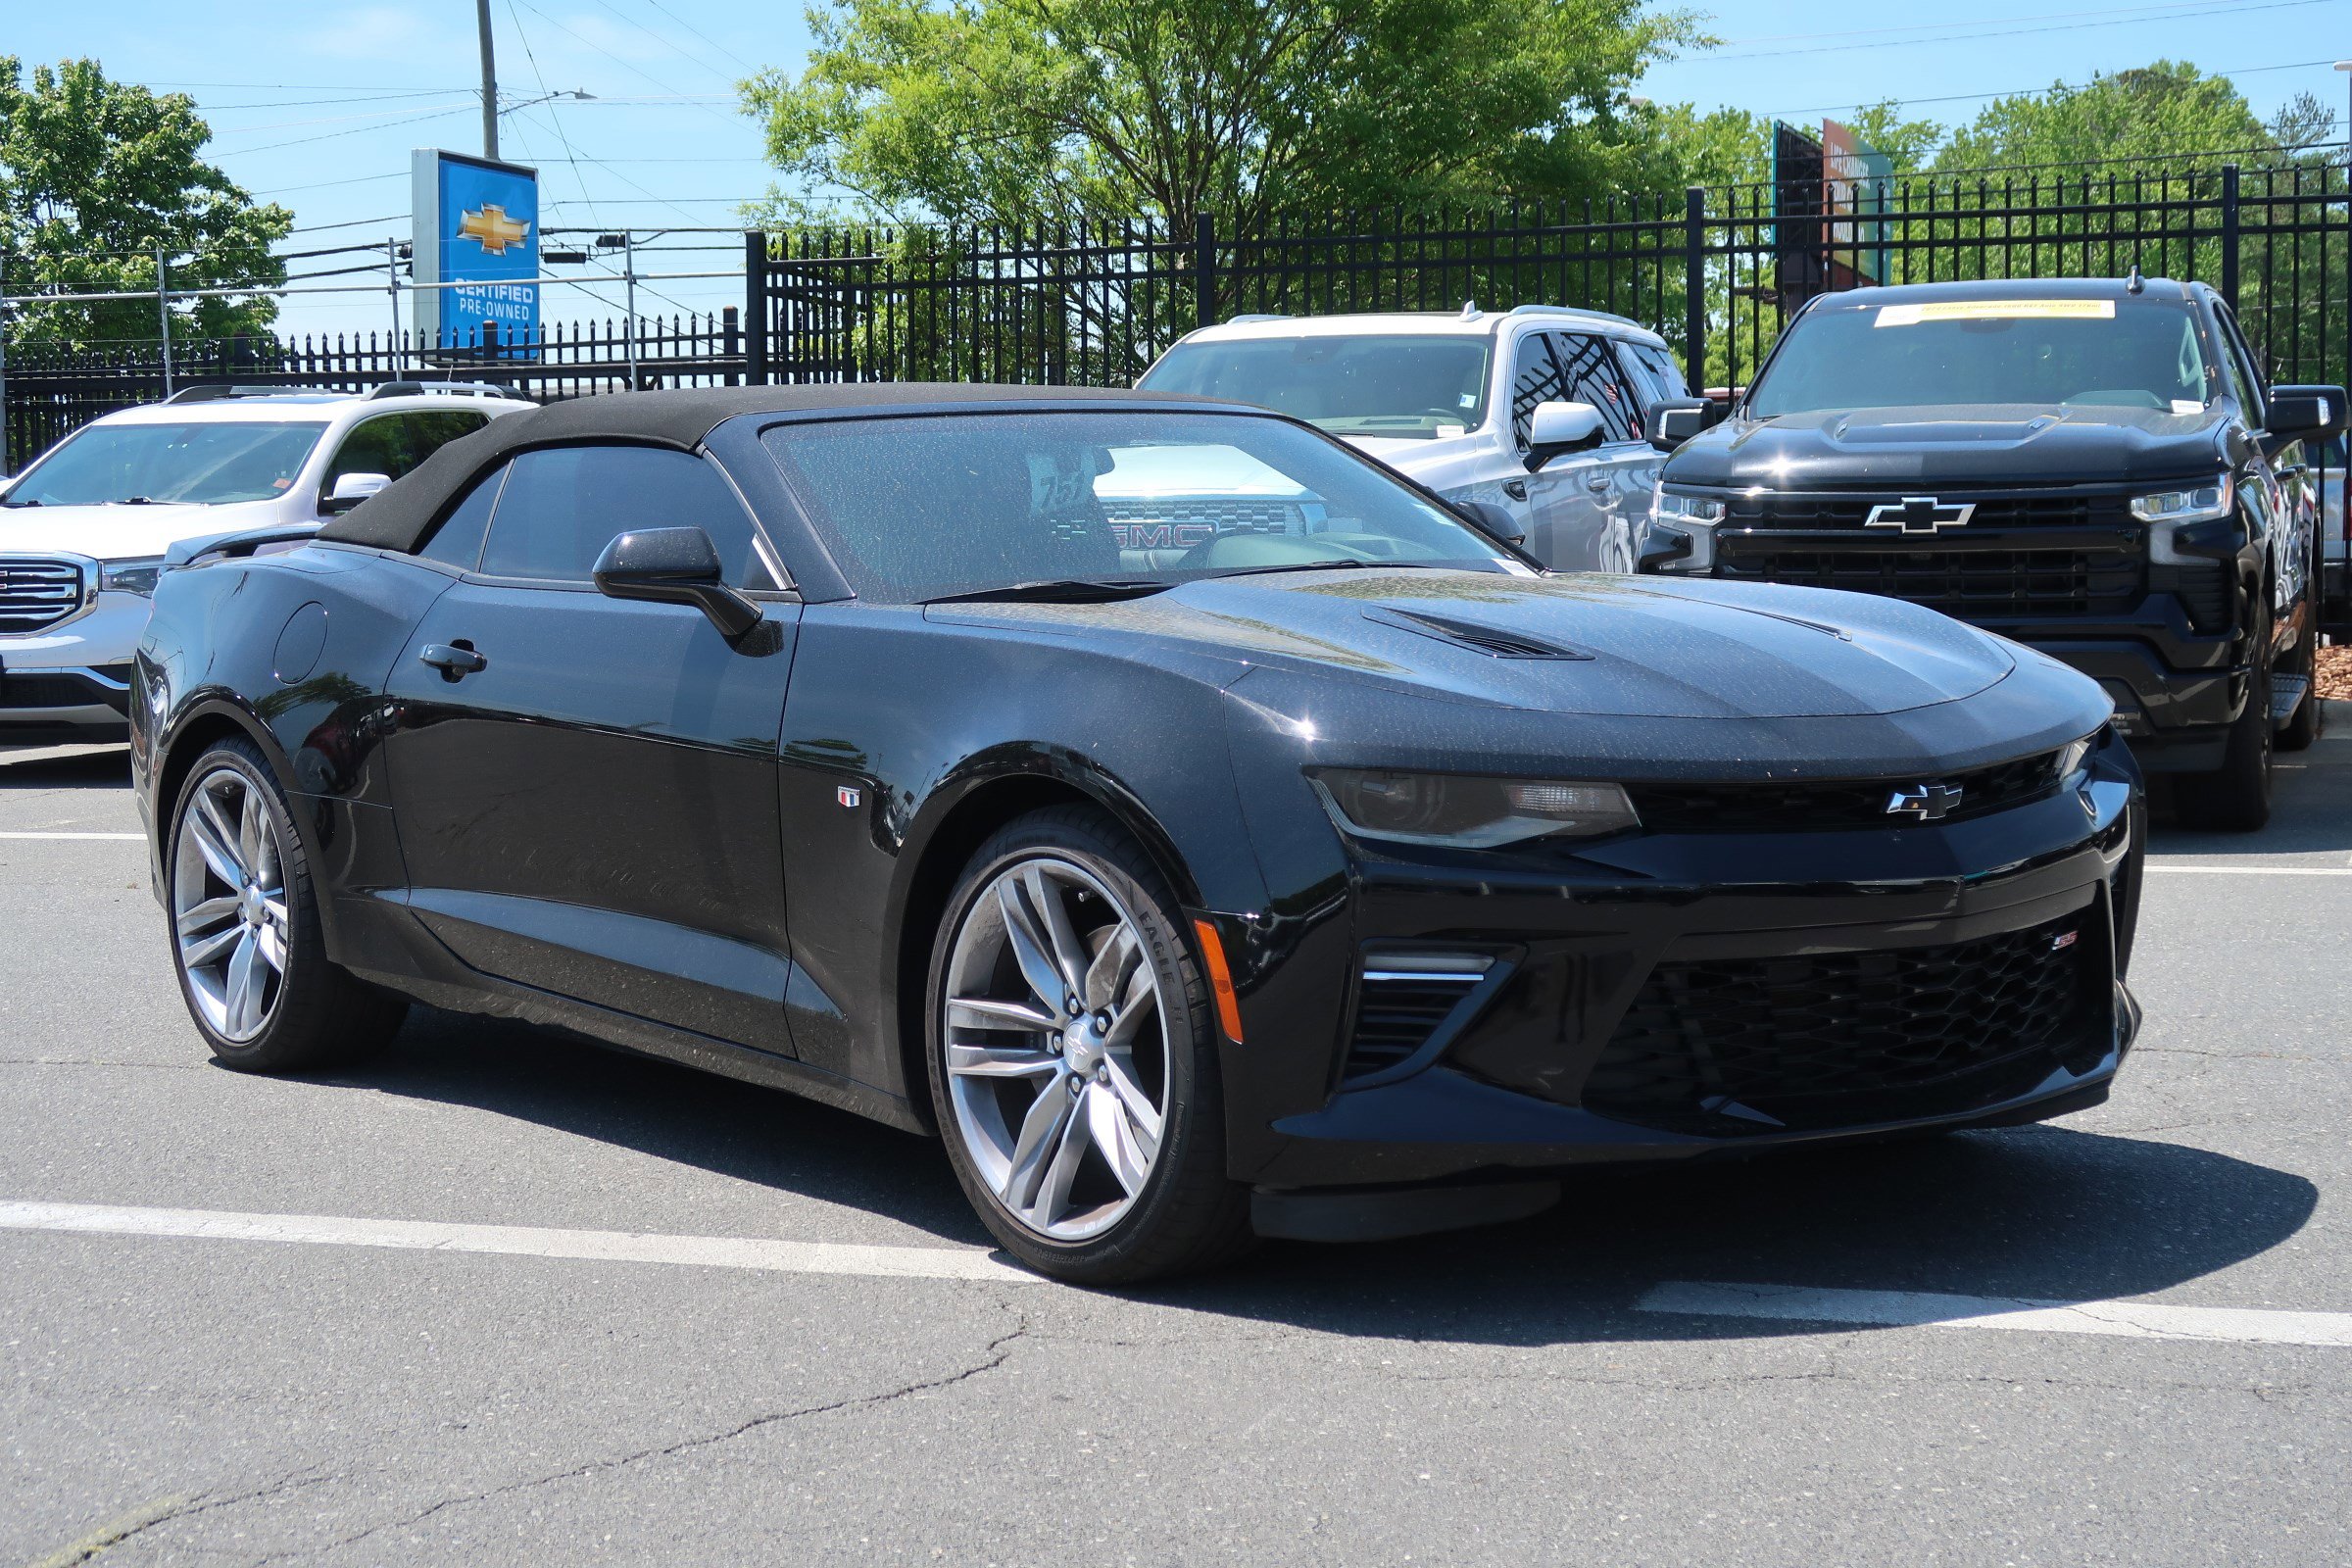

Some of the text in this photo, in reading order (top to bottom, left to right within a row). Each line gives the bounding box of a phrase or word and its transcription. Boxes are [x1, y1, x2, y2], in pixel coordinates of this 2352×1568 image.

[455, 278, 533, 304] CERTIFIED
[460, 297, 529, 320] PRE-OWNED
[1139, 910, 1176, 986] EAGLE
